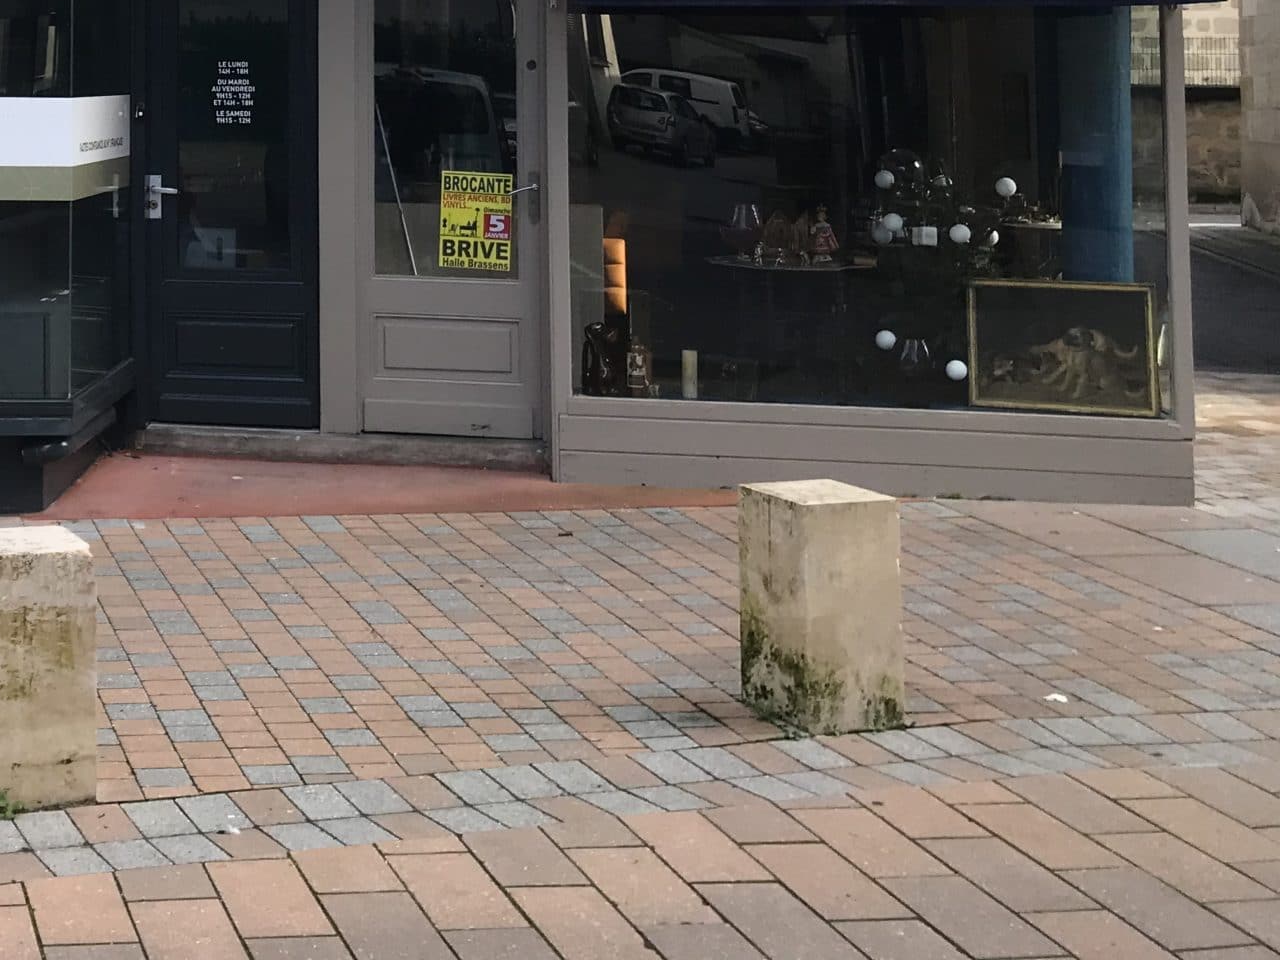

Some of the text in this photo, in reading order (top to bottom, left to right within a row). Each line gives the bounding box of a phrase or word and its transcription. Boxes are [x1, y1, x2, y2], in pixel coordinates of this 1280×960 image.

[443, 176, 512, 194] BROCANTE
[489, 215, 505, 232] 5
[442, 239, 509, 260] BRIVE
[468, 258, 509, 270] Brassens
